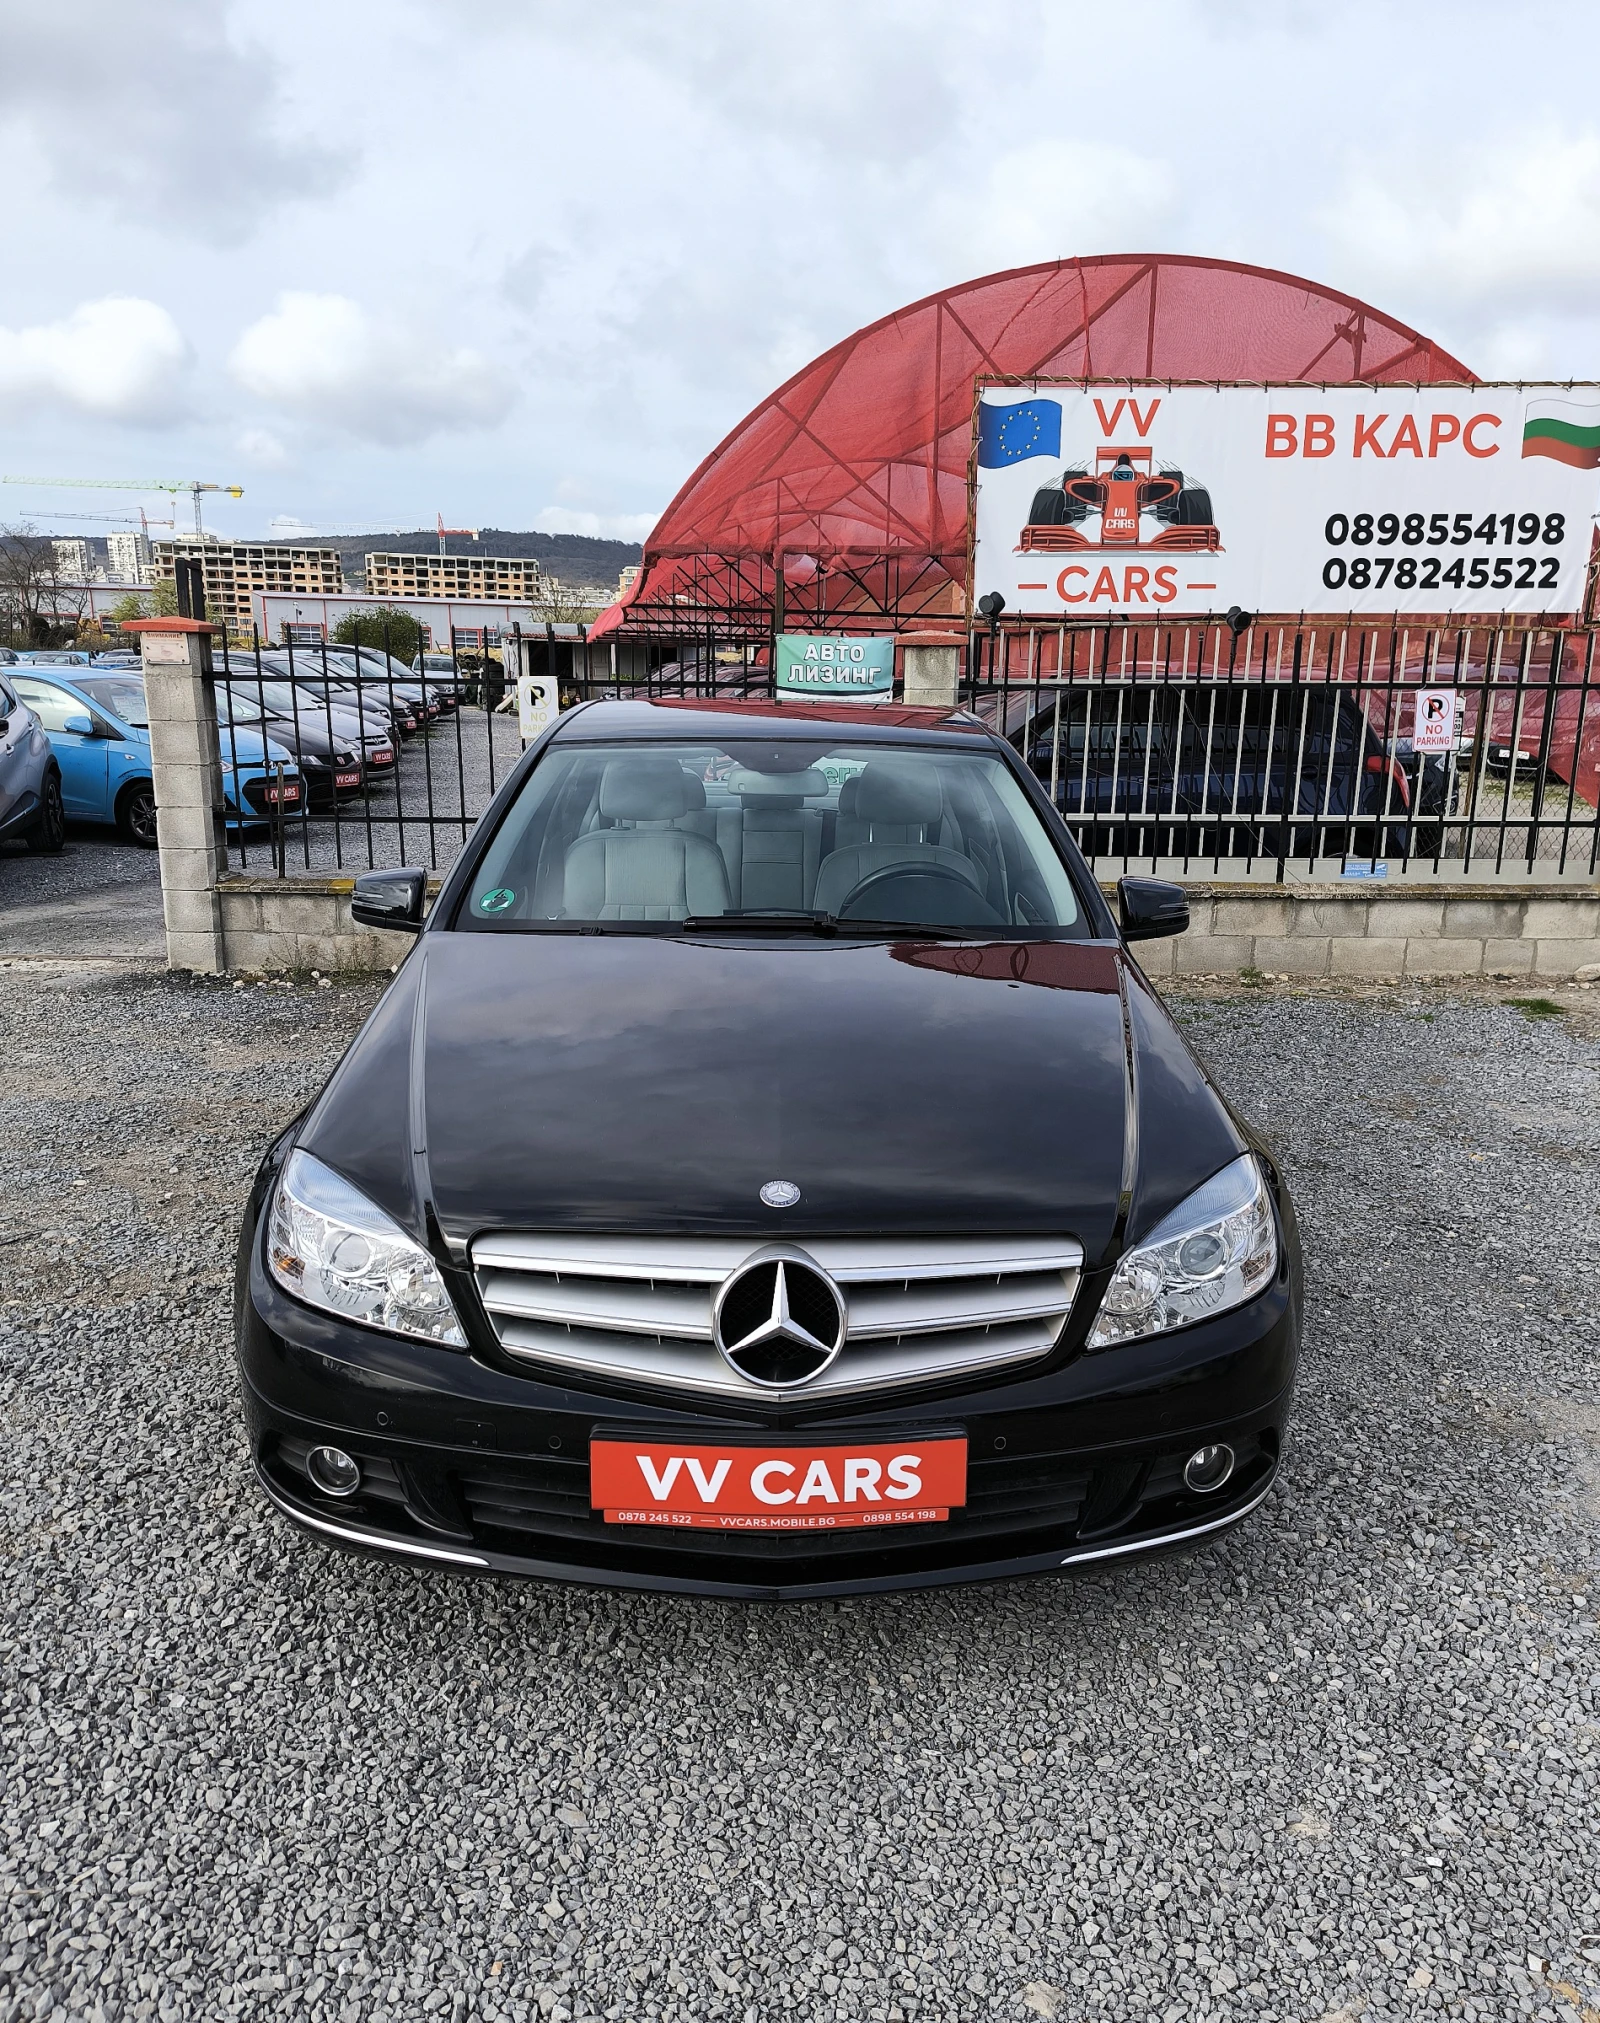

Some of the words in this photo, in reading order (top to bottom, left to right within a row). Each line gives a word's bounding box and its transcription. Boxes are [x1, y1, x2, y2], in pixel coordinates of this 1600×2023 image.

[1093, 398, 1162, 437] VV
[1265, 414, 1336, 458] ВВ
[1352, 413, 1503, 459] КАРС
[1114, 507, 1128, 517] VV
[1105, 518, 1136, 529] CARS
[1324, 512, 1566, 546] 0898554198
[1322, 557, 1560, 590] 0878245522
[1056, 565, 1178, 603] CARS
[804, 643, 865, 663] АВТО
[788, 664, 882, 684] ЛИЗИНГ
[530, 712, 548, 722] NO
[1425, 724, 1443, 735] NO
[1416, 736, 1450, 746] PARKING
[283, 787, 296, 798] ARS
[635, 1455, 733, 1503] VV
[749, 1454, 923, 1506] CARS
[618, 1512, 646, 1522] 0878
[649, 1513, 670, 1523] 245
[672, 1515, 692, 1525] 522
[719, 1516, 836, 1528] VVCARS.MOBILE.BG
[862, 1512, 892, 1523] 0898
[895, 1511, 915, 1521] 554
[917, 1510, 937, 1520] 198
